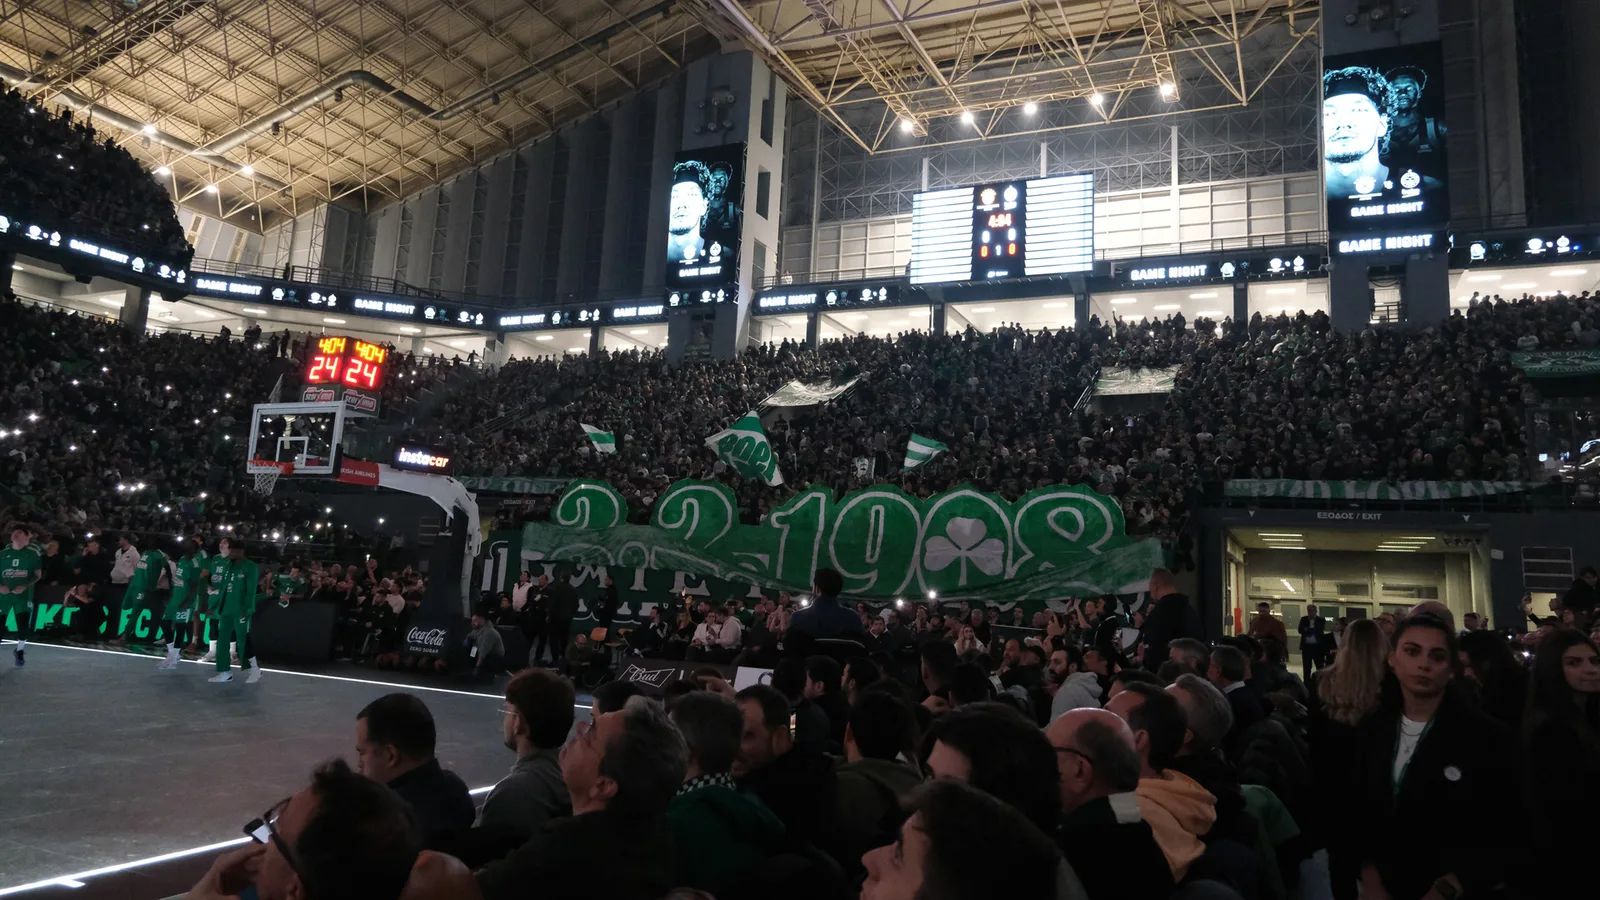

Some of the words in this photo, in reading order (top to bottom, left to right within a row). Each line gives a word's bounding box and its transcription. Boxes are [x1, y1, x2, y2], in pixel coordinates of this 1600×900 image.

[996, 244, 1001, 256] 1
[319, 337, 346, 355] 4:04
[354, 341, 385, 363] 4:04
[308, 356, 339, 379] 24
[345, 359, 378, 387] 24
[398, 447, 450, 468] instacar
[355, 469, 376, 478] AIRLINES
[1316, 512, 1354, 520] ΕΞΟΔΟΣ
[406, 626, 448, 646] Coca-Cola
[629, 667, 660, 682] Bud
